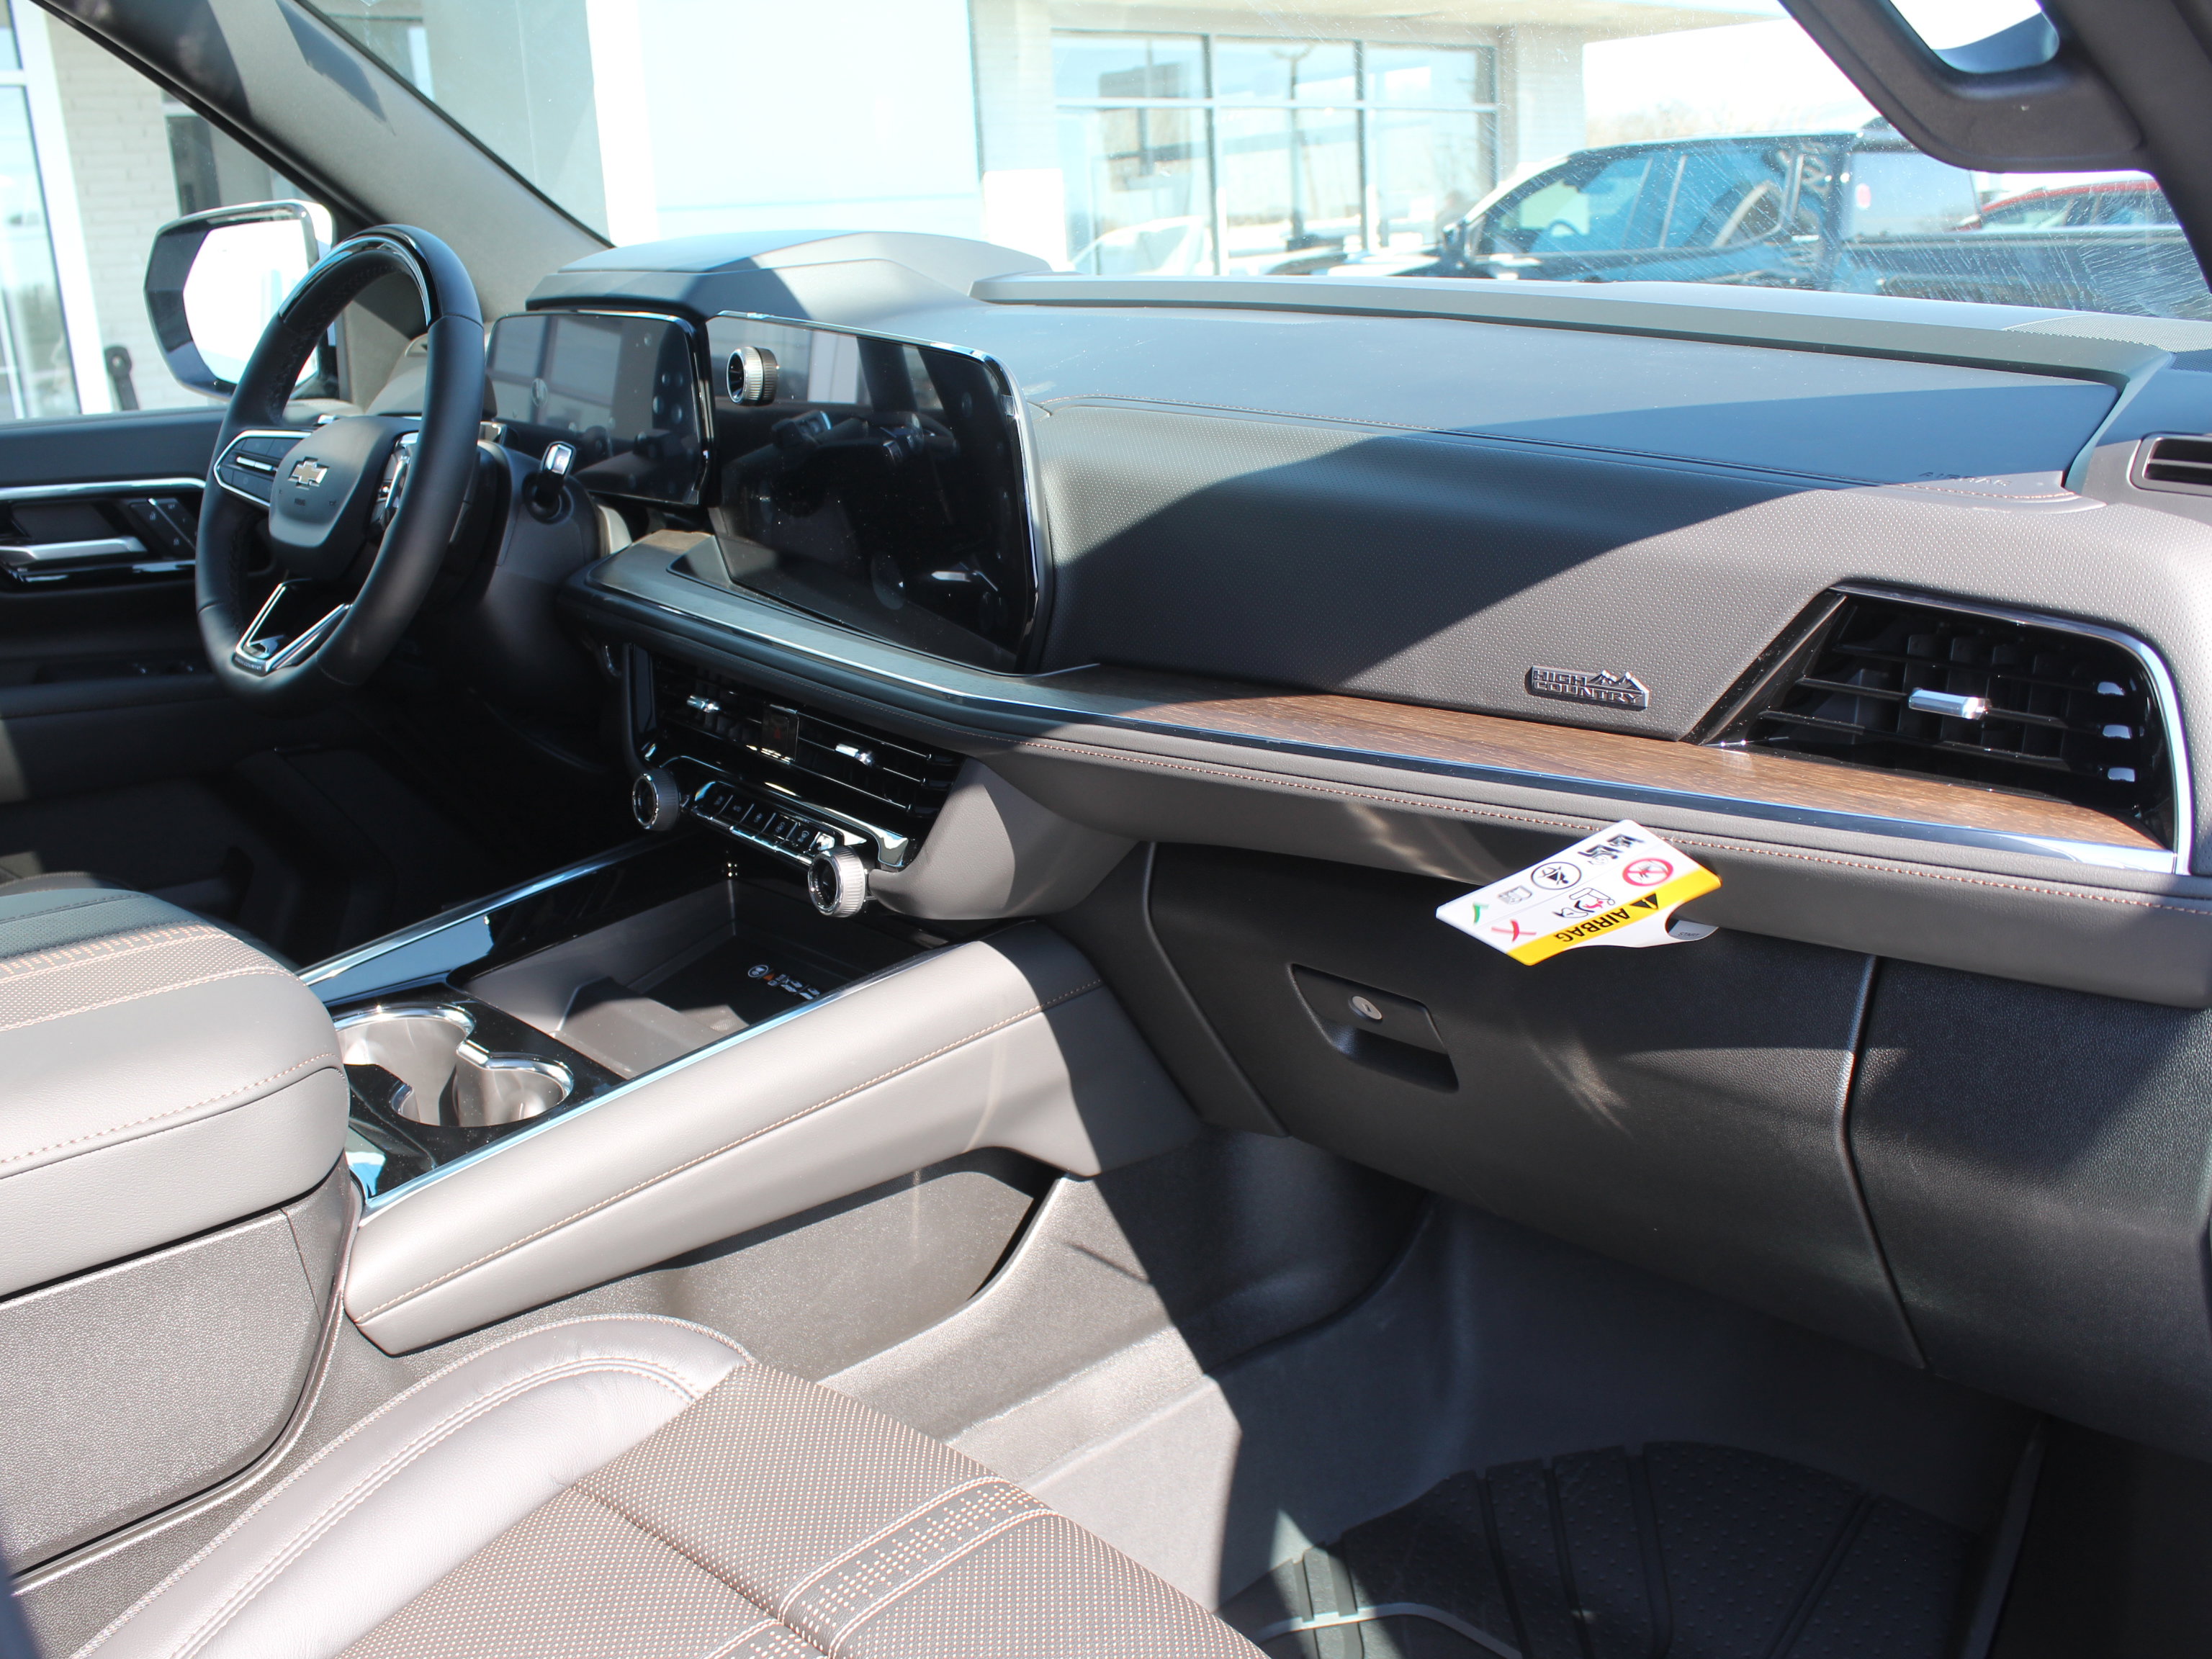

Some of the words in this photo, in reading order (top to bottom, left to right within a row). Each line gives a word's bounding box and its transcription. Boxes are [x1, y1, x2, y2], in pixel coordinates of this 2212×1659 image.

[1533, 670, 1588, 686] HIGH
[1533, 680, 1642, 703] COUNTRY
[1554, 908, 1630, 942] AIRBAG
